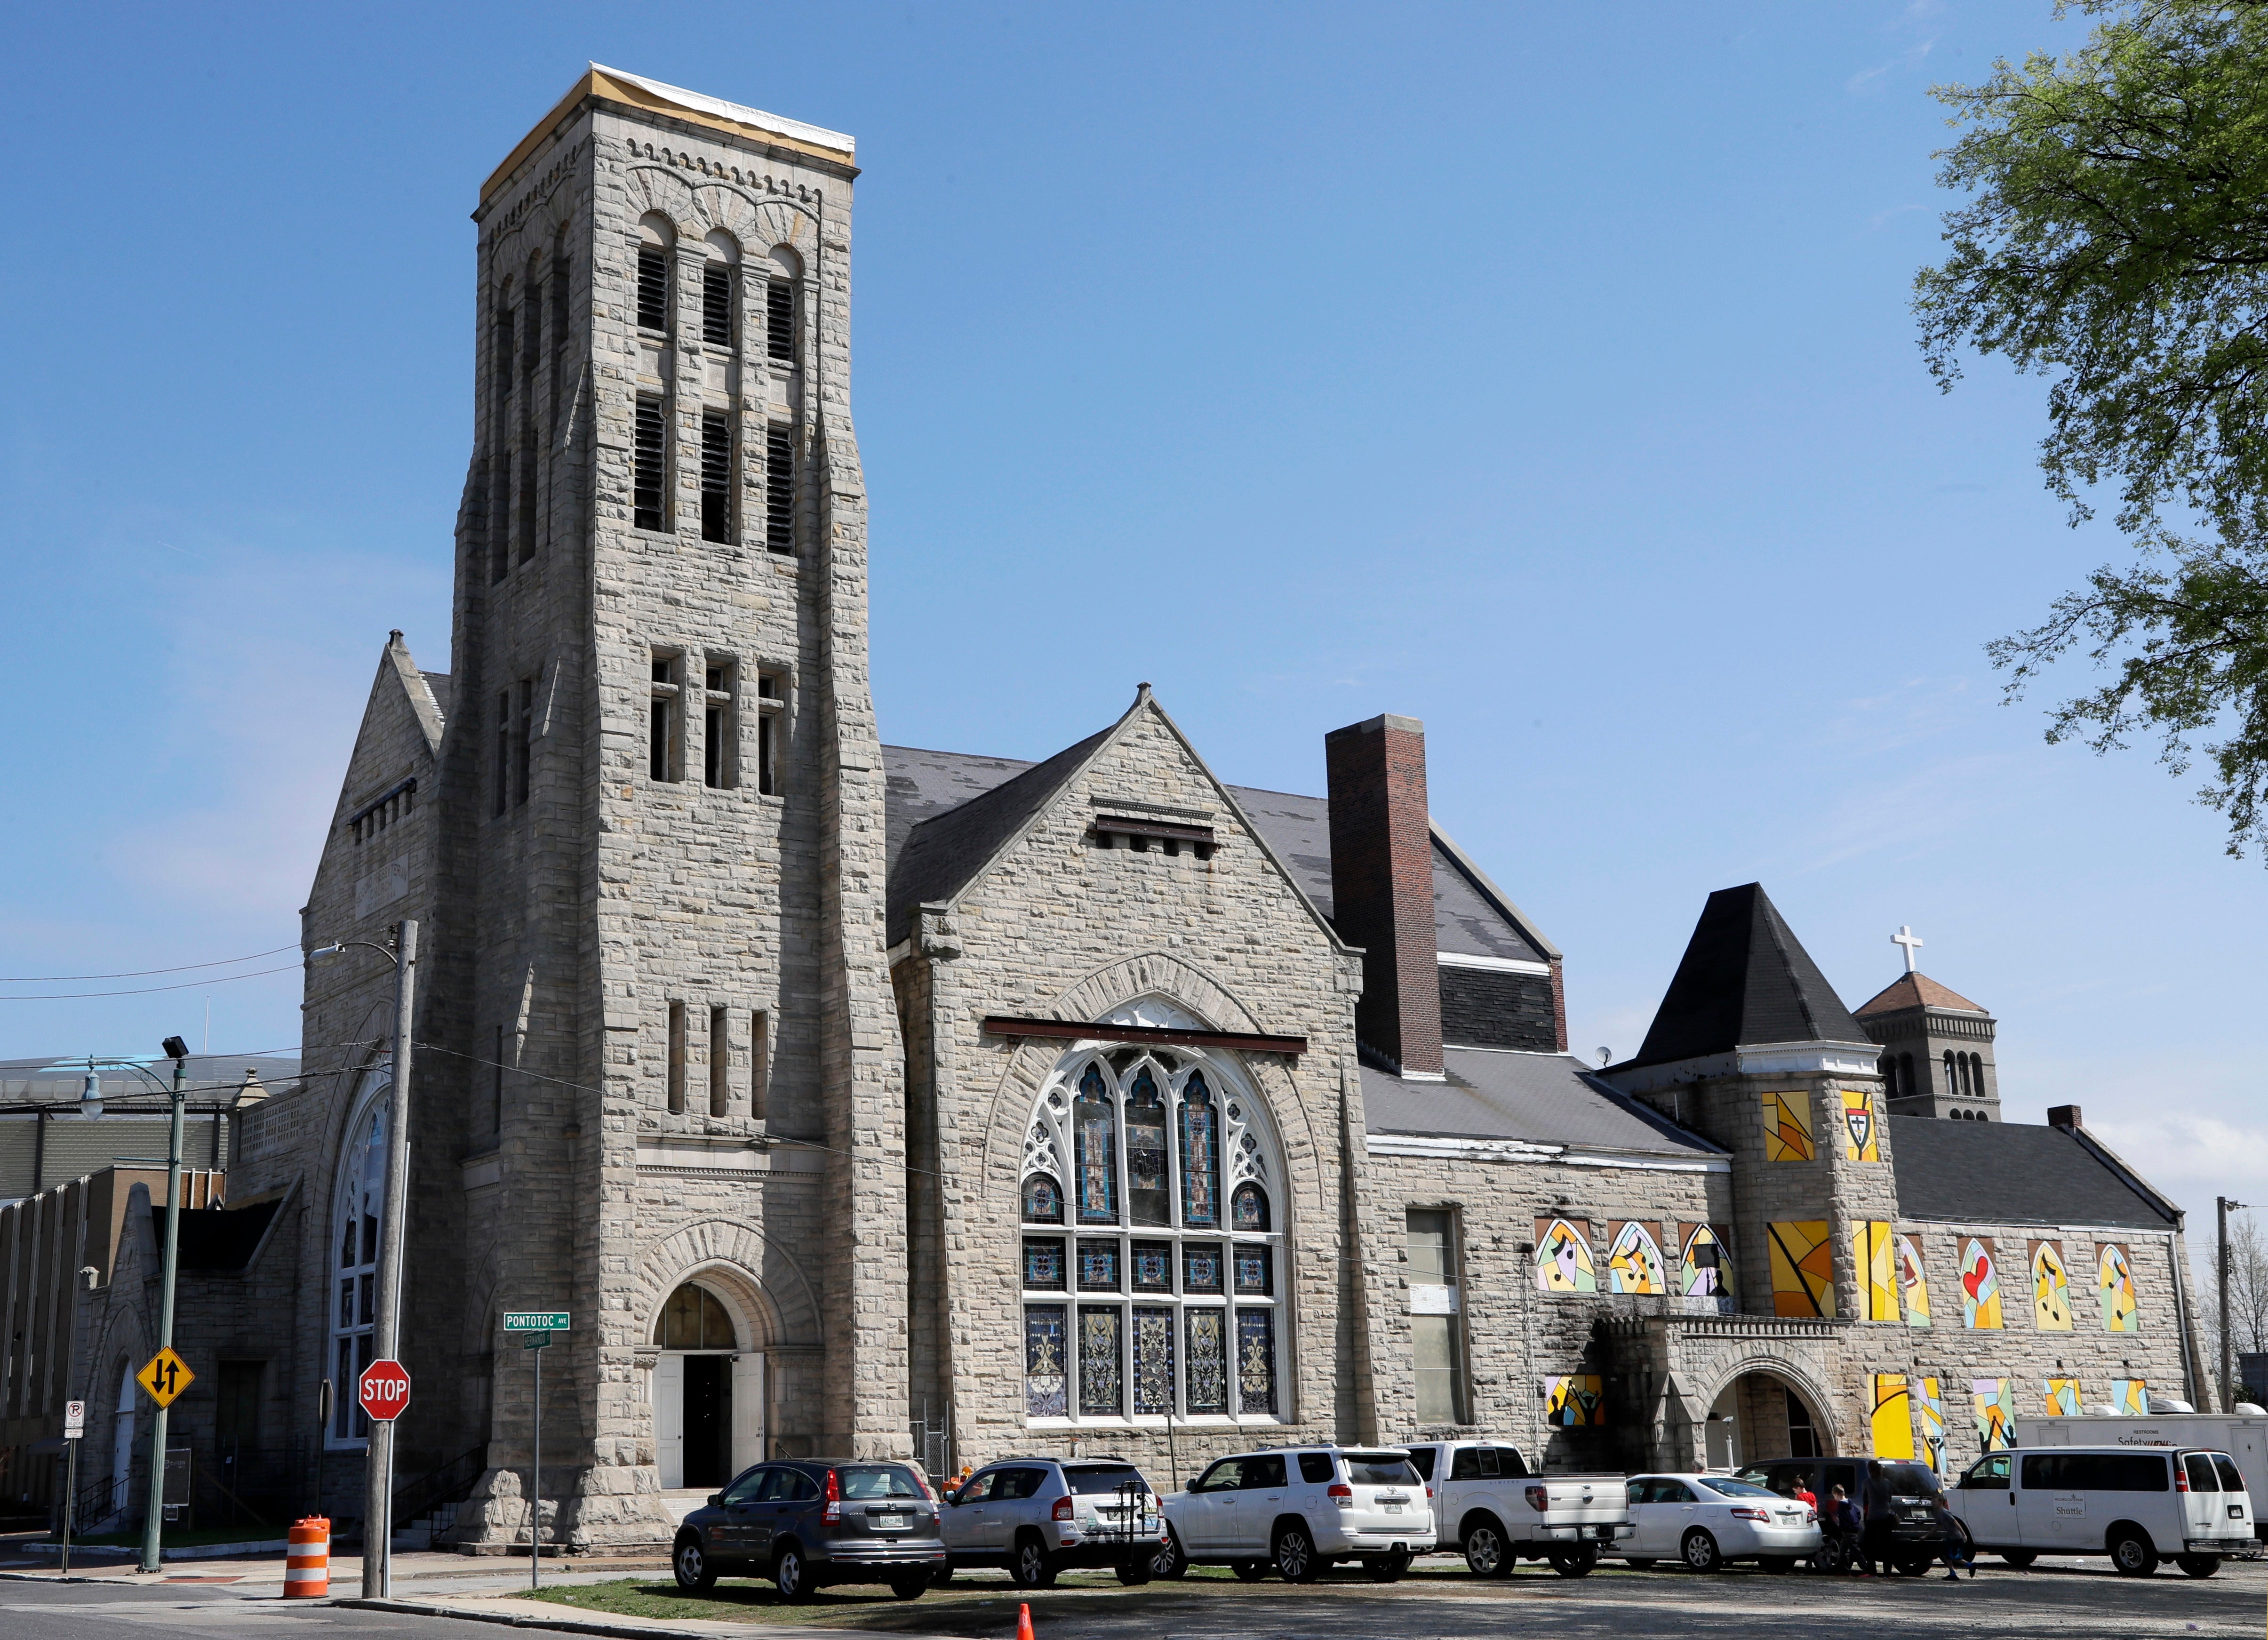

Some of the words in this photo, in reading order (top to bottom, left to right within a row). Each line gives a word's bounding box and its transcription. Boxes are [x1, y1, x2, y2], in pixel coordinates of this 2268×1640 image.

[370, 877, 392, 900] CHURCH
[507, 1315, 554, 1327] PONTOTOC
[524, 1333, 546, 1347] HERNANDO
[363, 1378, 407, 1401] STOP
[2056, 1506, 2083, 1515] Shuttle
